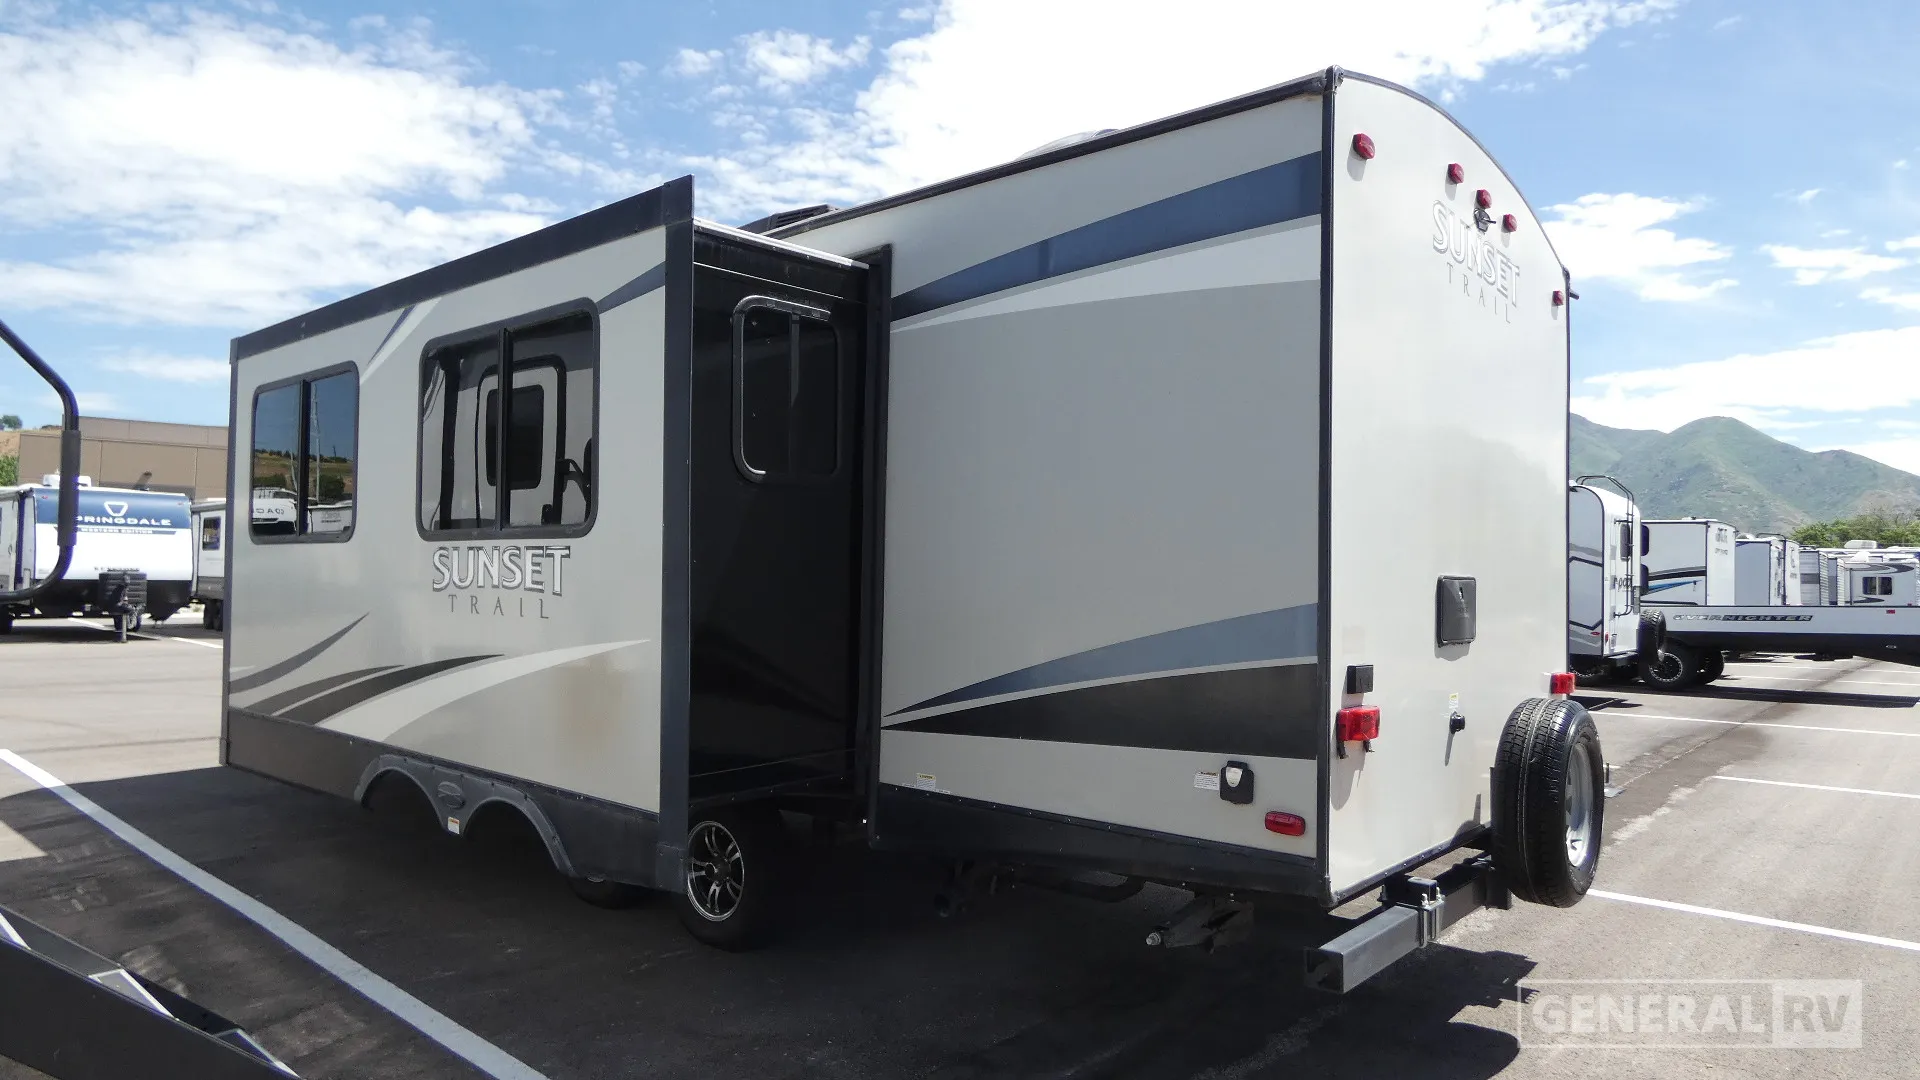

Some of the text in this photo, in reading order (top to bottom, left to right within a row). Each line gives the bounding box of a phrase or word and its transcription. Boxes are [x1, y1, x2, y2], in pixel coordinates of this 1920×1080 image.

[1432, 200, 1520, 308] SUNSET
[1446, 262, 1511, 324] TRAIL
[77, 515, 171, 526] PRINGDALE
[432, 545, 571, 597] SUNSET
[448, 594, 549, 620] TRAIL
[1673, 614, 1813, 622] OVERNIGHTER
